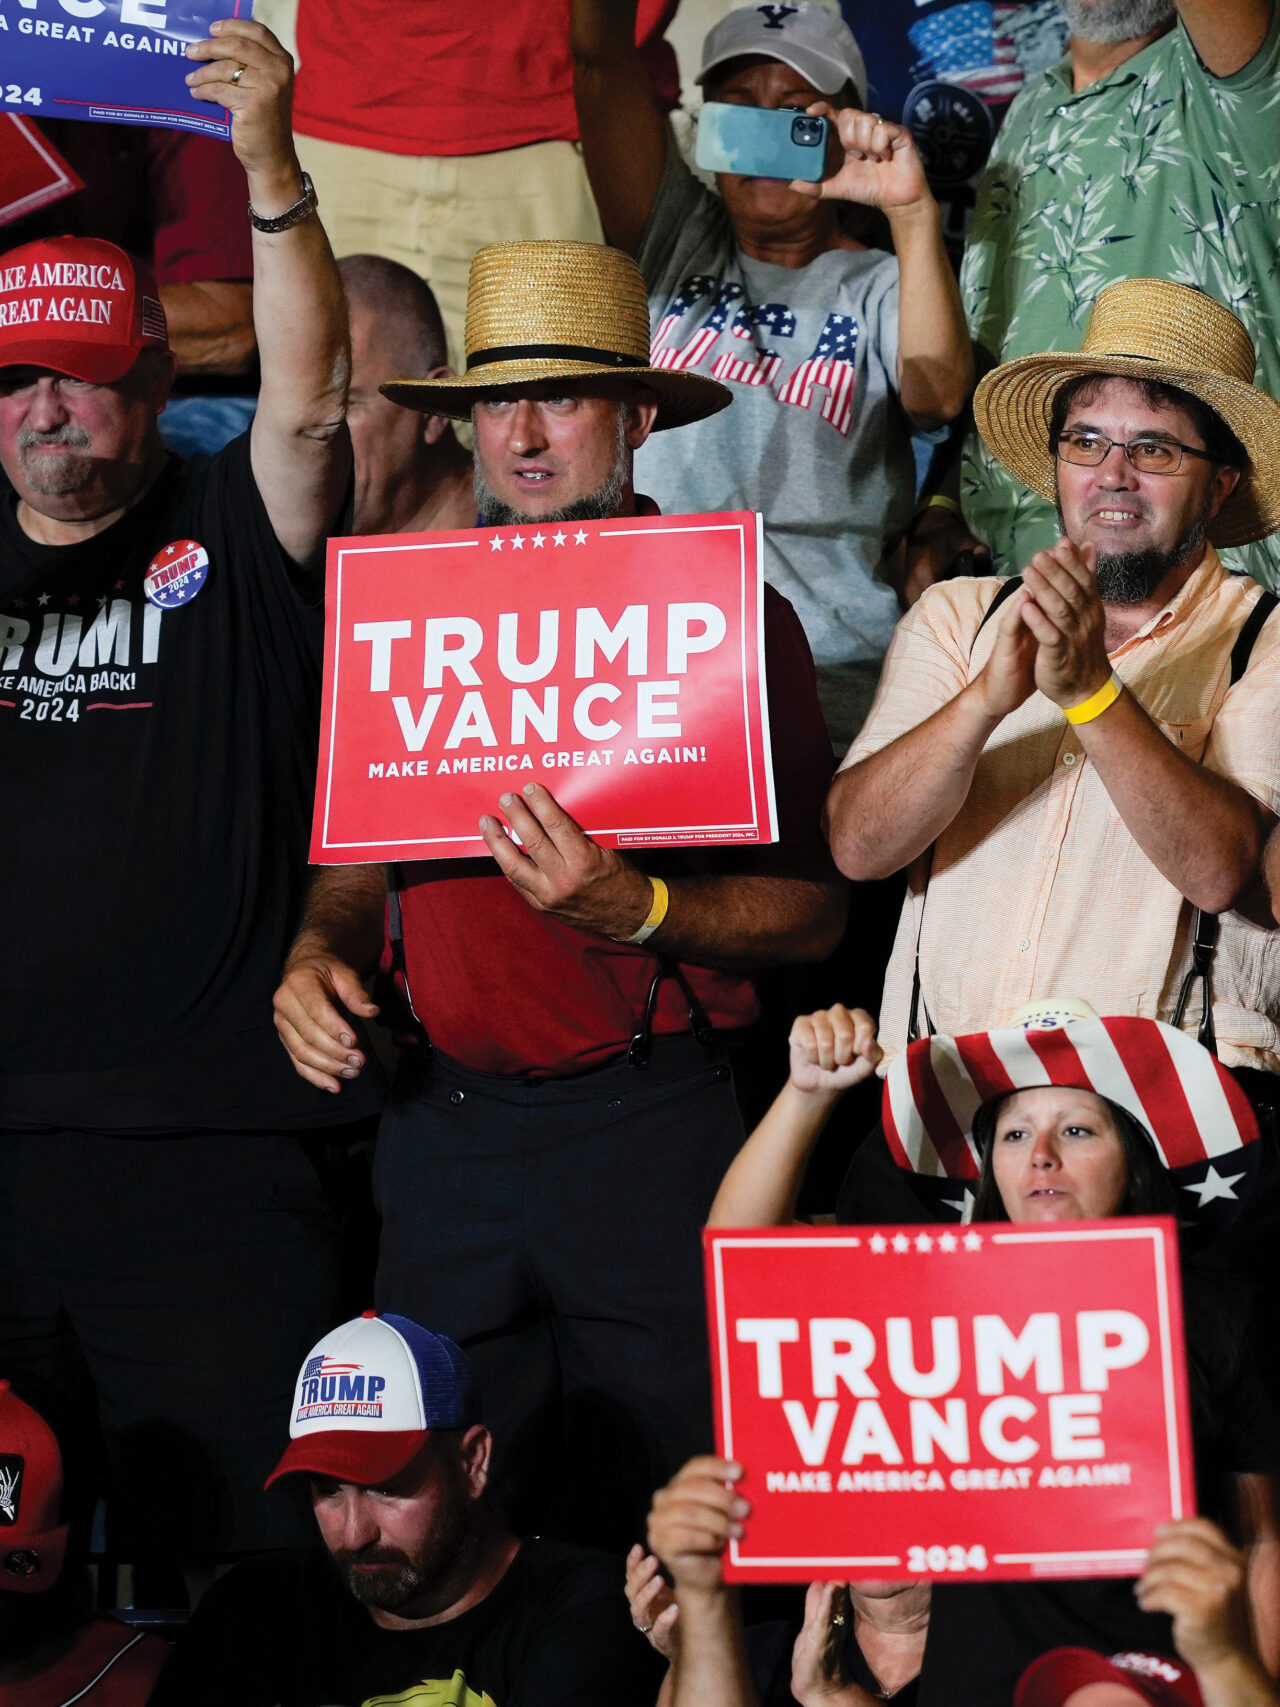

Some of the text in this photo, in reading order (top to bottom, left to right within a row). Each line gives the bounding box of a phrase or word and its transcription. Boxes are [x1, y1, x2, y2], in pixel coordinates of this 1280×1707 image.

[757, 4, 799, 29] Y
[18, 18, 95, 43] GREAT
[103, 31, 187, 56] AGAIN!
[0, 84, 43, 106] 24
[27, 263, 126, 291] AMERICA
[45, 297, 112, 326] AGAIN
[650, 275, 859, 437] USA
[151, 552, 199, 589] TRUMP
[167, 574, 190, 594] 2024
[352, 601, 728, 692] TRUMP
[16, 673, 86, 698] AMERICA
[90, 671, 136, 693] BACK!
[20, 697, 80, 722] 2024
[391, 680, 683, 752] VANCE
[368, 746, 707, 779] MAKE AMERICA GREAT AGAIN!
[735, 1310, 1150, 1399] TRUMP
[301, 1375, 385, 1406] TRUMP
[308, 1404, 332, 1417] AMERICA
[333, 1404, 355, 1416] GREAT
[356, 1404, 379, 1416] AGAIN
[782, 1394, 1105, 1466] VANCE
[767, 1464, 1131, 1493] MAKE AMERICA GREAT AGAIN!
[907, 1545, 988, 1572] 2024
